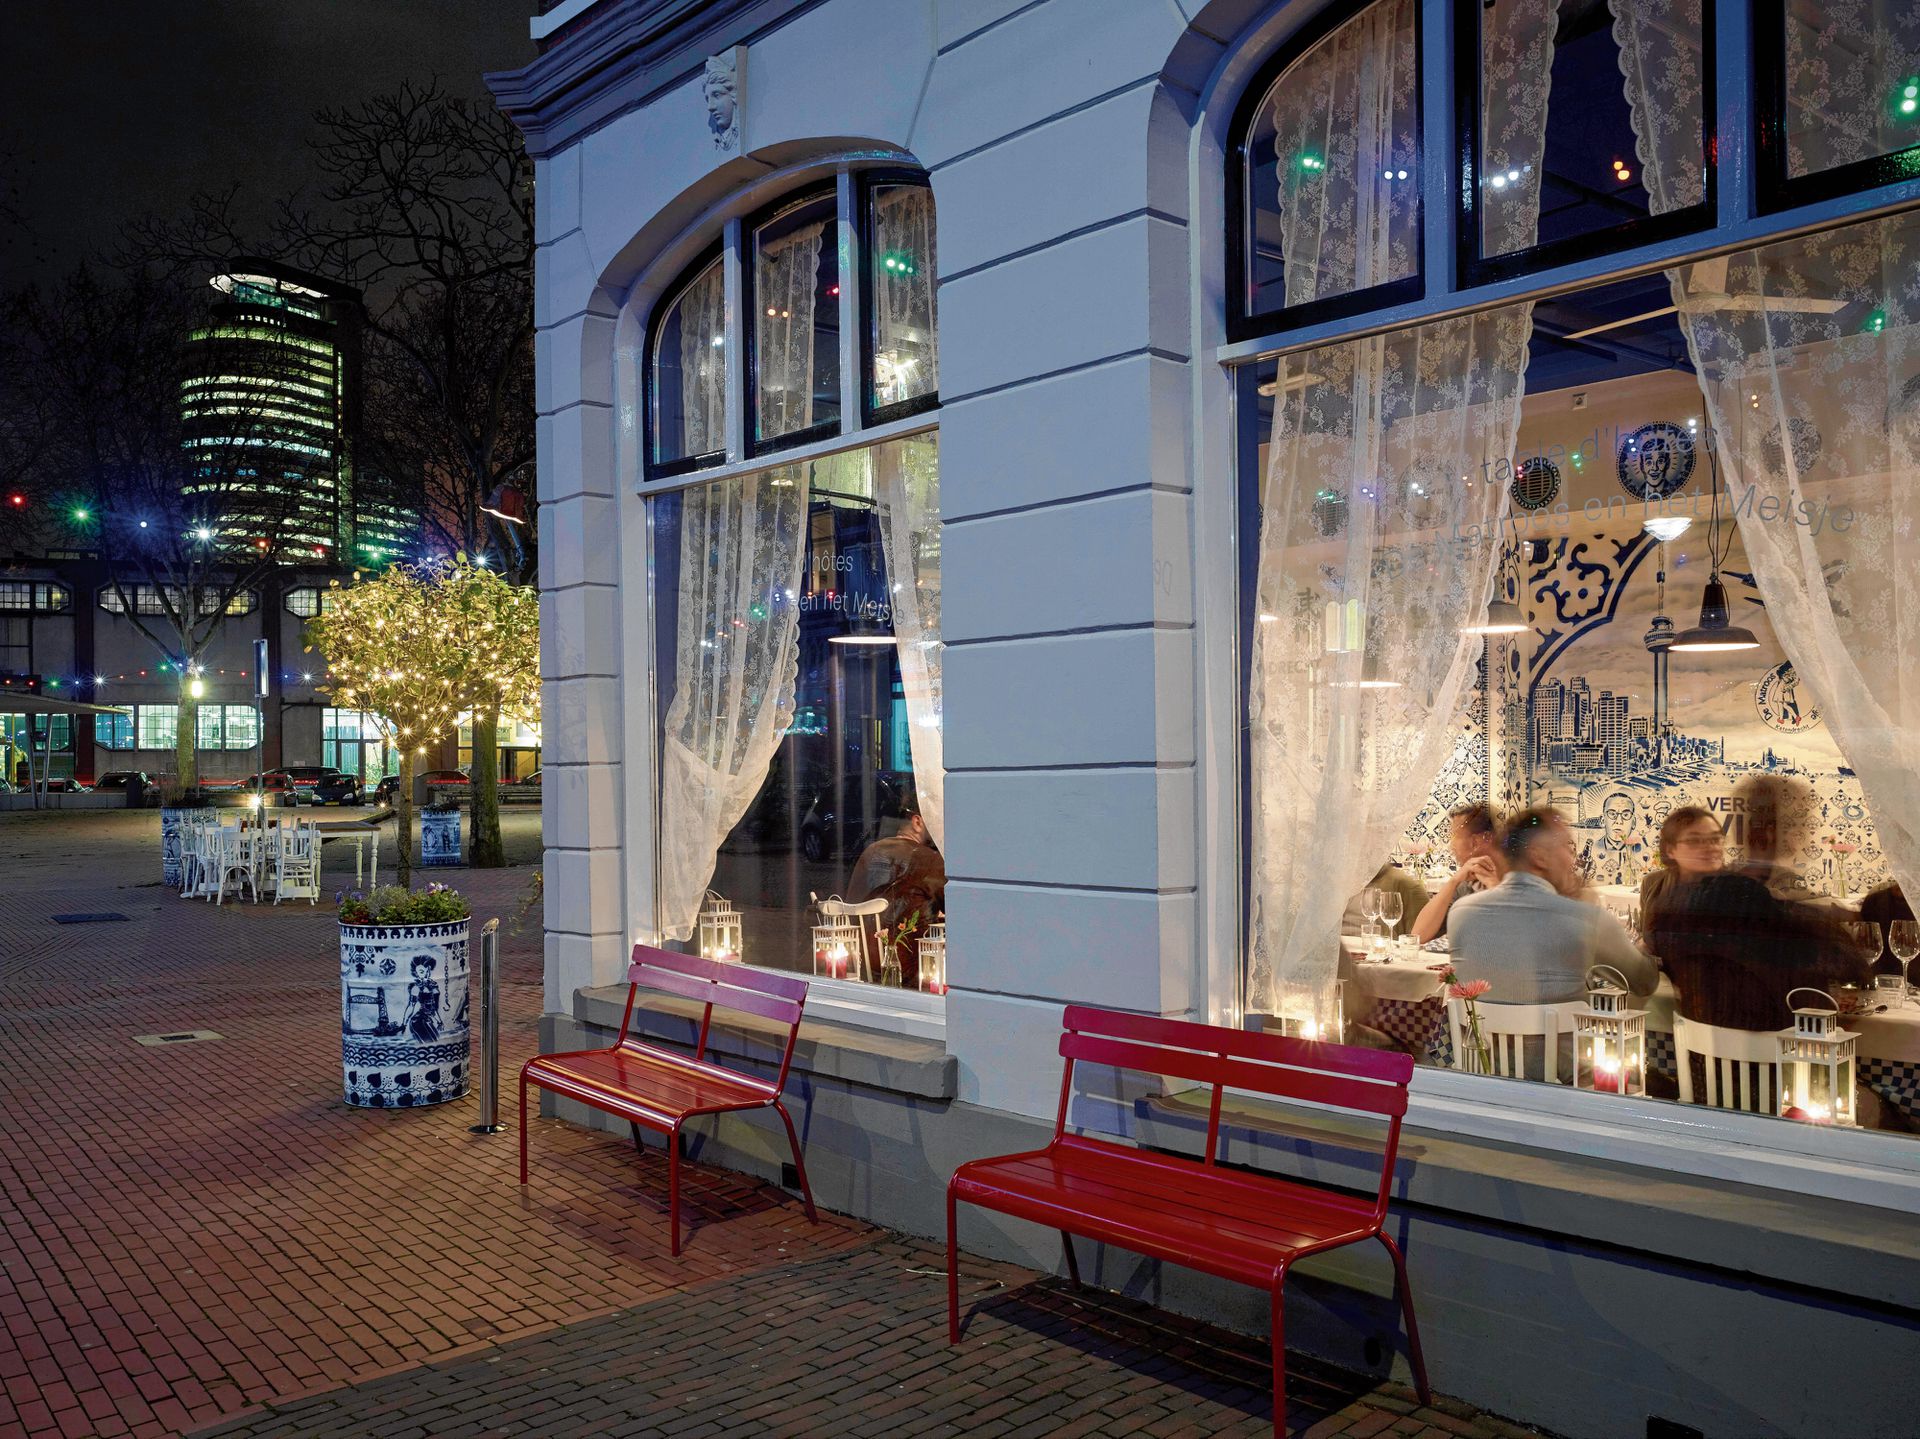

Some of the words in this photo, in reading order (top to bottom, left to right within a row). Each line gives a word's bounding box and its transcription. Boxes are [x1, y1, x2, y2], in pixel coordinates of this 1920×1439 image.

[1481, 439, 1566, 484] table
[1584, 493, 1628, 522] en
[1643, 484, 1701, 516] het
[1720, 483, 1855, 537] Meisje
[800, 594, 818, 612] en
[823, 588, 848, 611] het
[1757, 672, 1777, 706] Matroos
